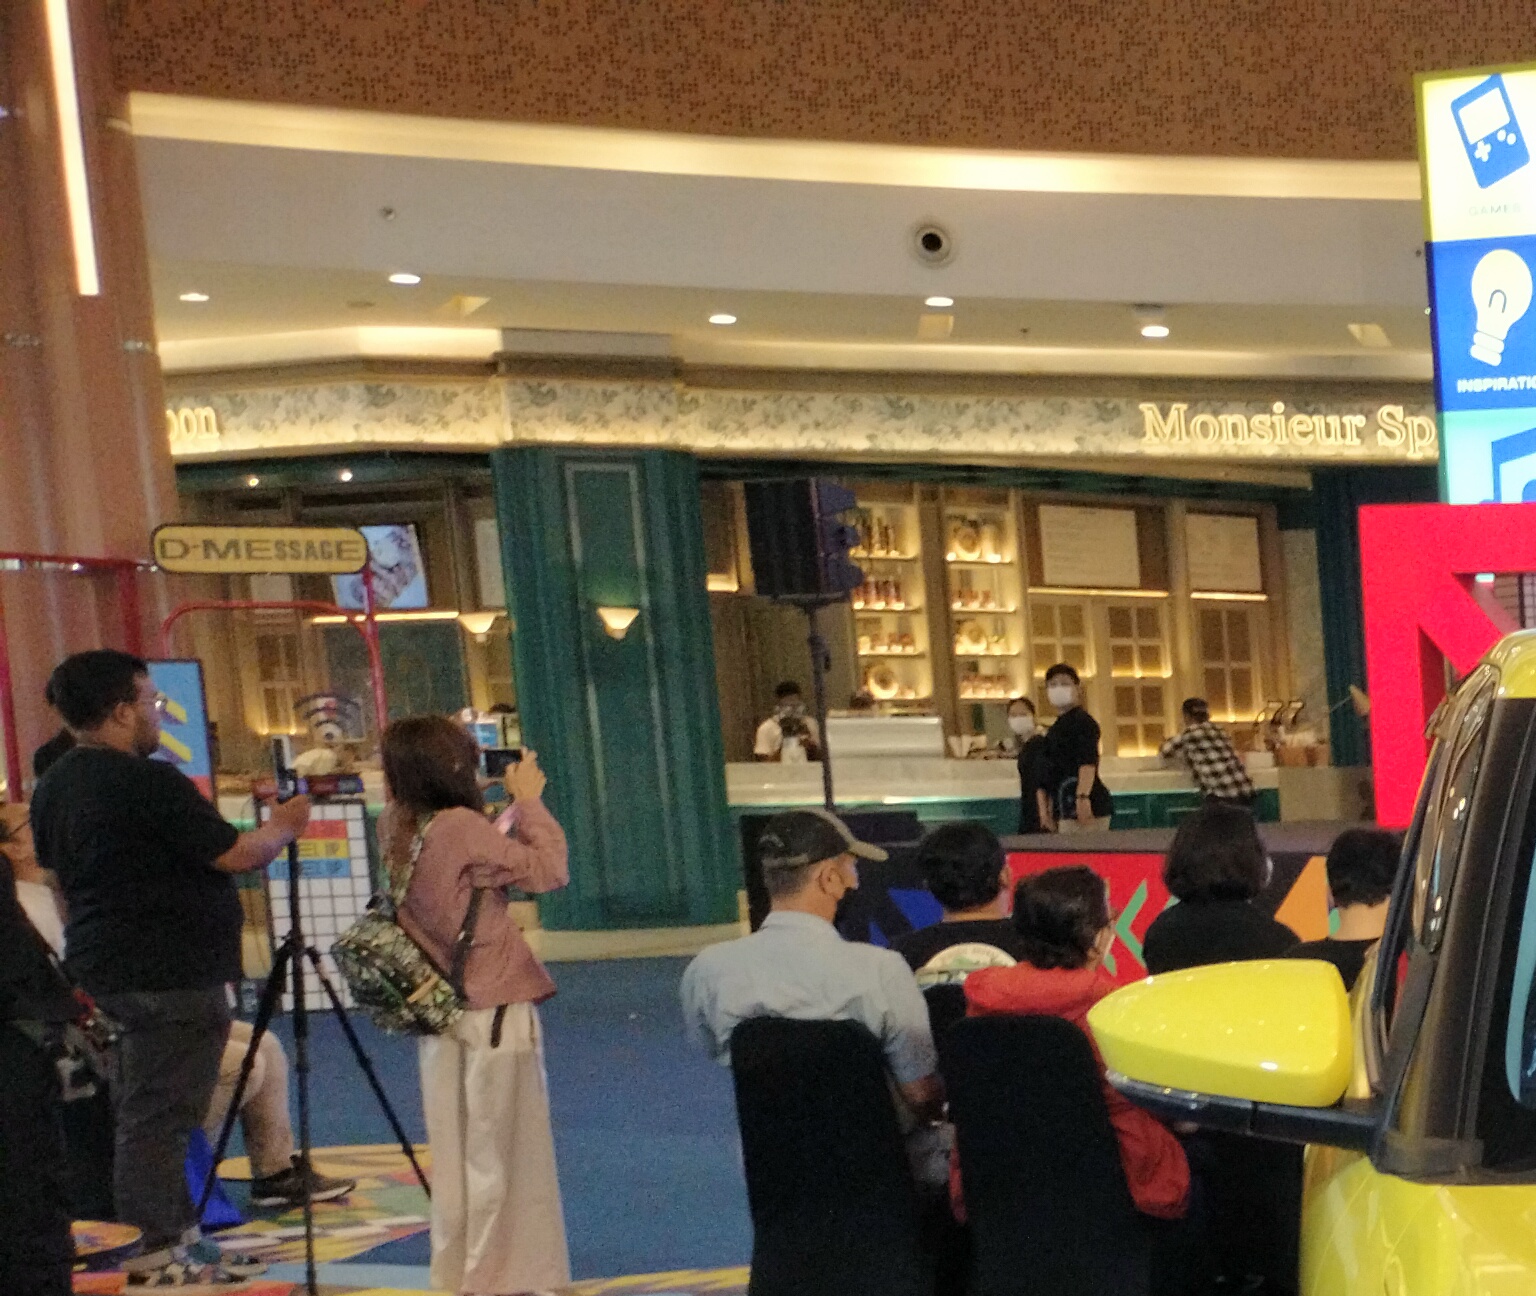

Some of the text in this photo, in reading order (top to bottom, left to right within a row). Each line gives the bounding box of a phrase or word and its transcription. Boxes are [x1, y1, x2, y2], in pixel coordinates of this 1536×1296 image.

[1139, 401, 1437, 460] Monsieur Sp
[159, 538, 363, 562] D-MESSAGE
